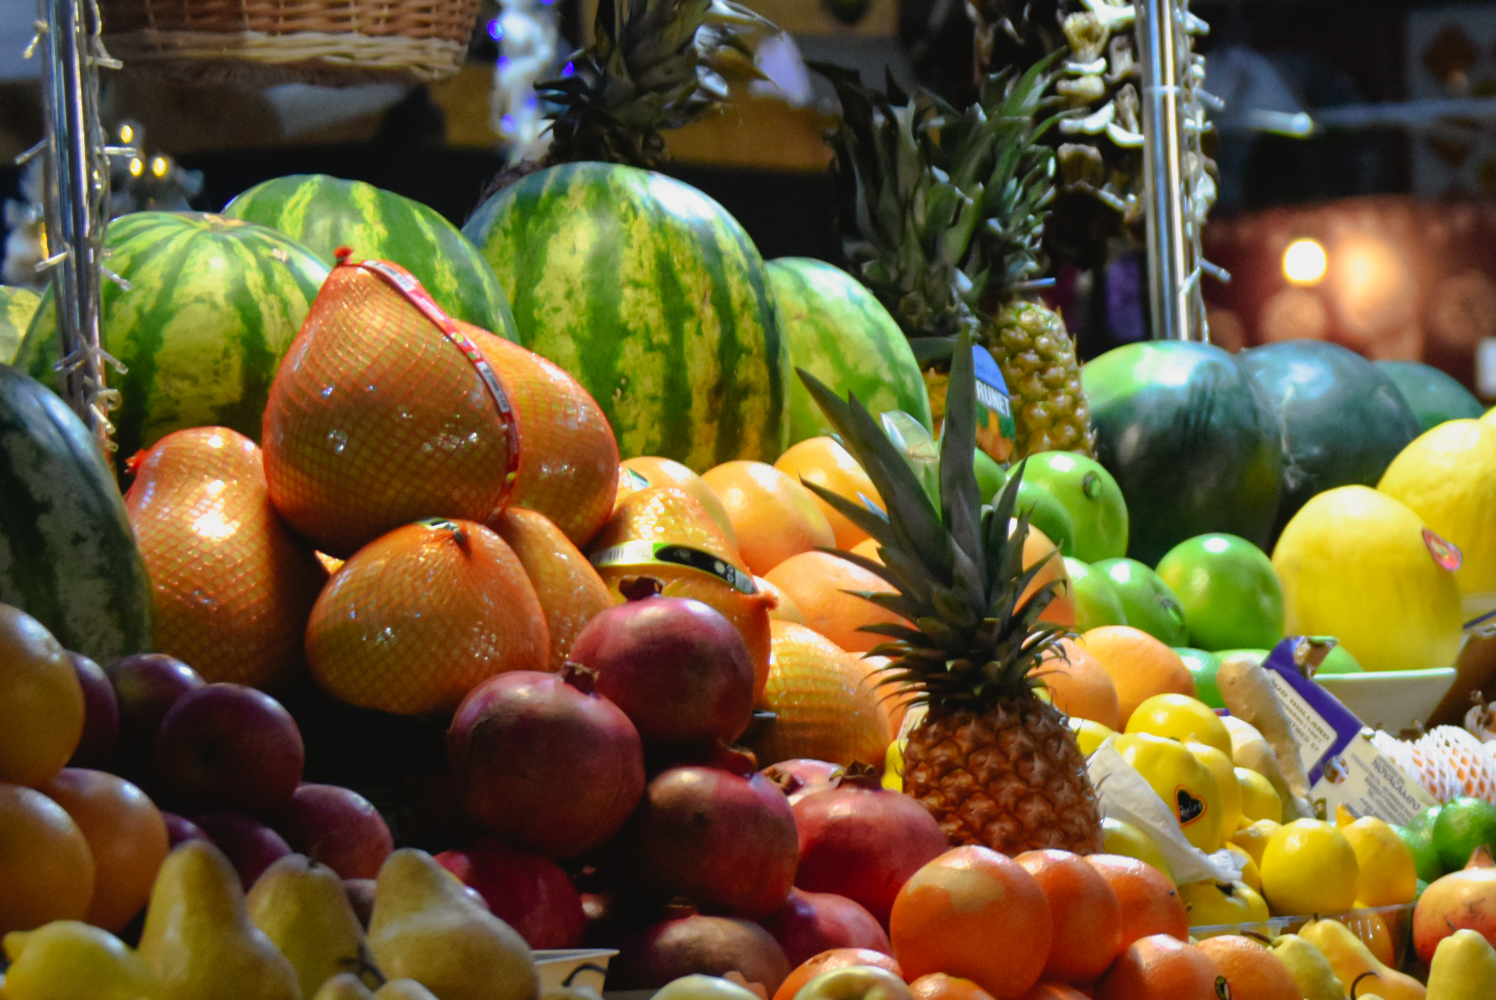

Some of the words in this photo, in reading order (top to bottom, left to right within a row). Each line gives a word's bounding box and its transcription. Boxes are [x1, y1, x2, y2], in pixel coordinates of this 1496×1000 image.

[975, 379, 1011, 418] RUNET
[1289, 698, 1330, 741] HOLLAND
[1372, 758, 1421, 811] NOVACAMPO
